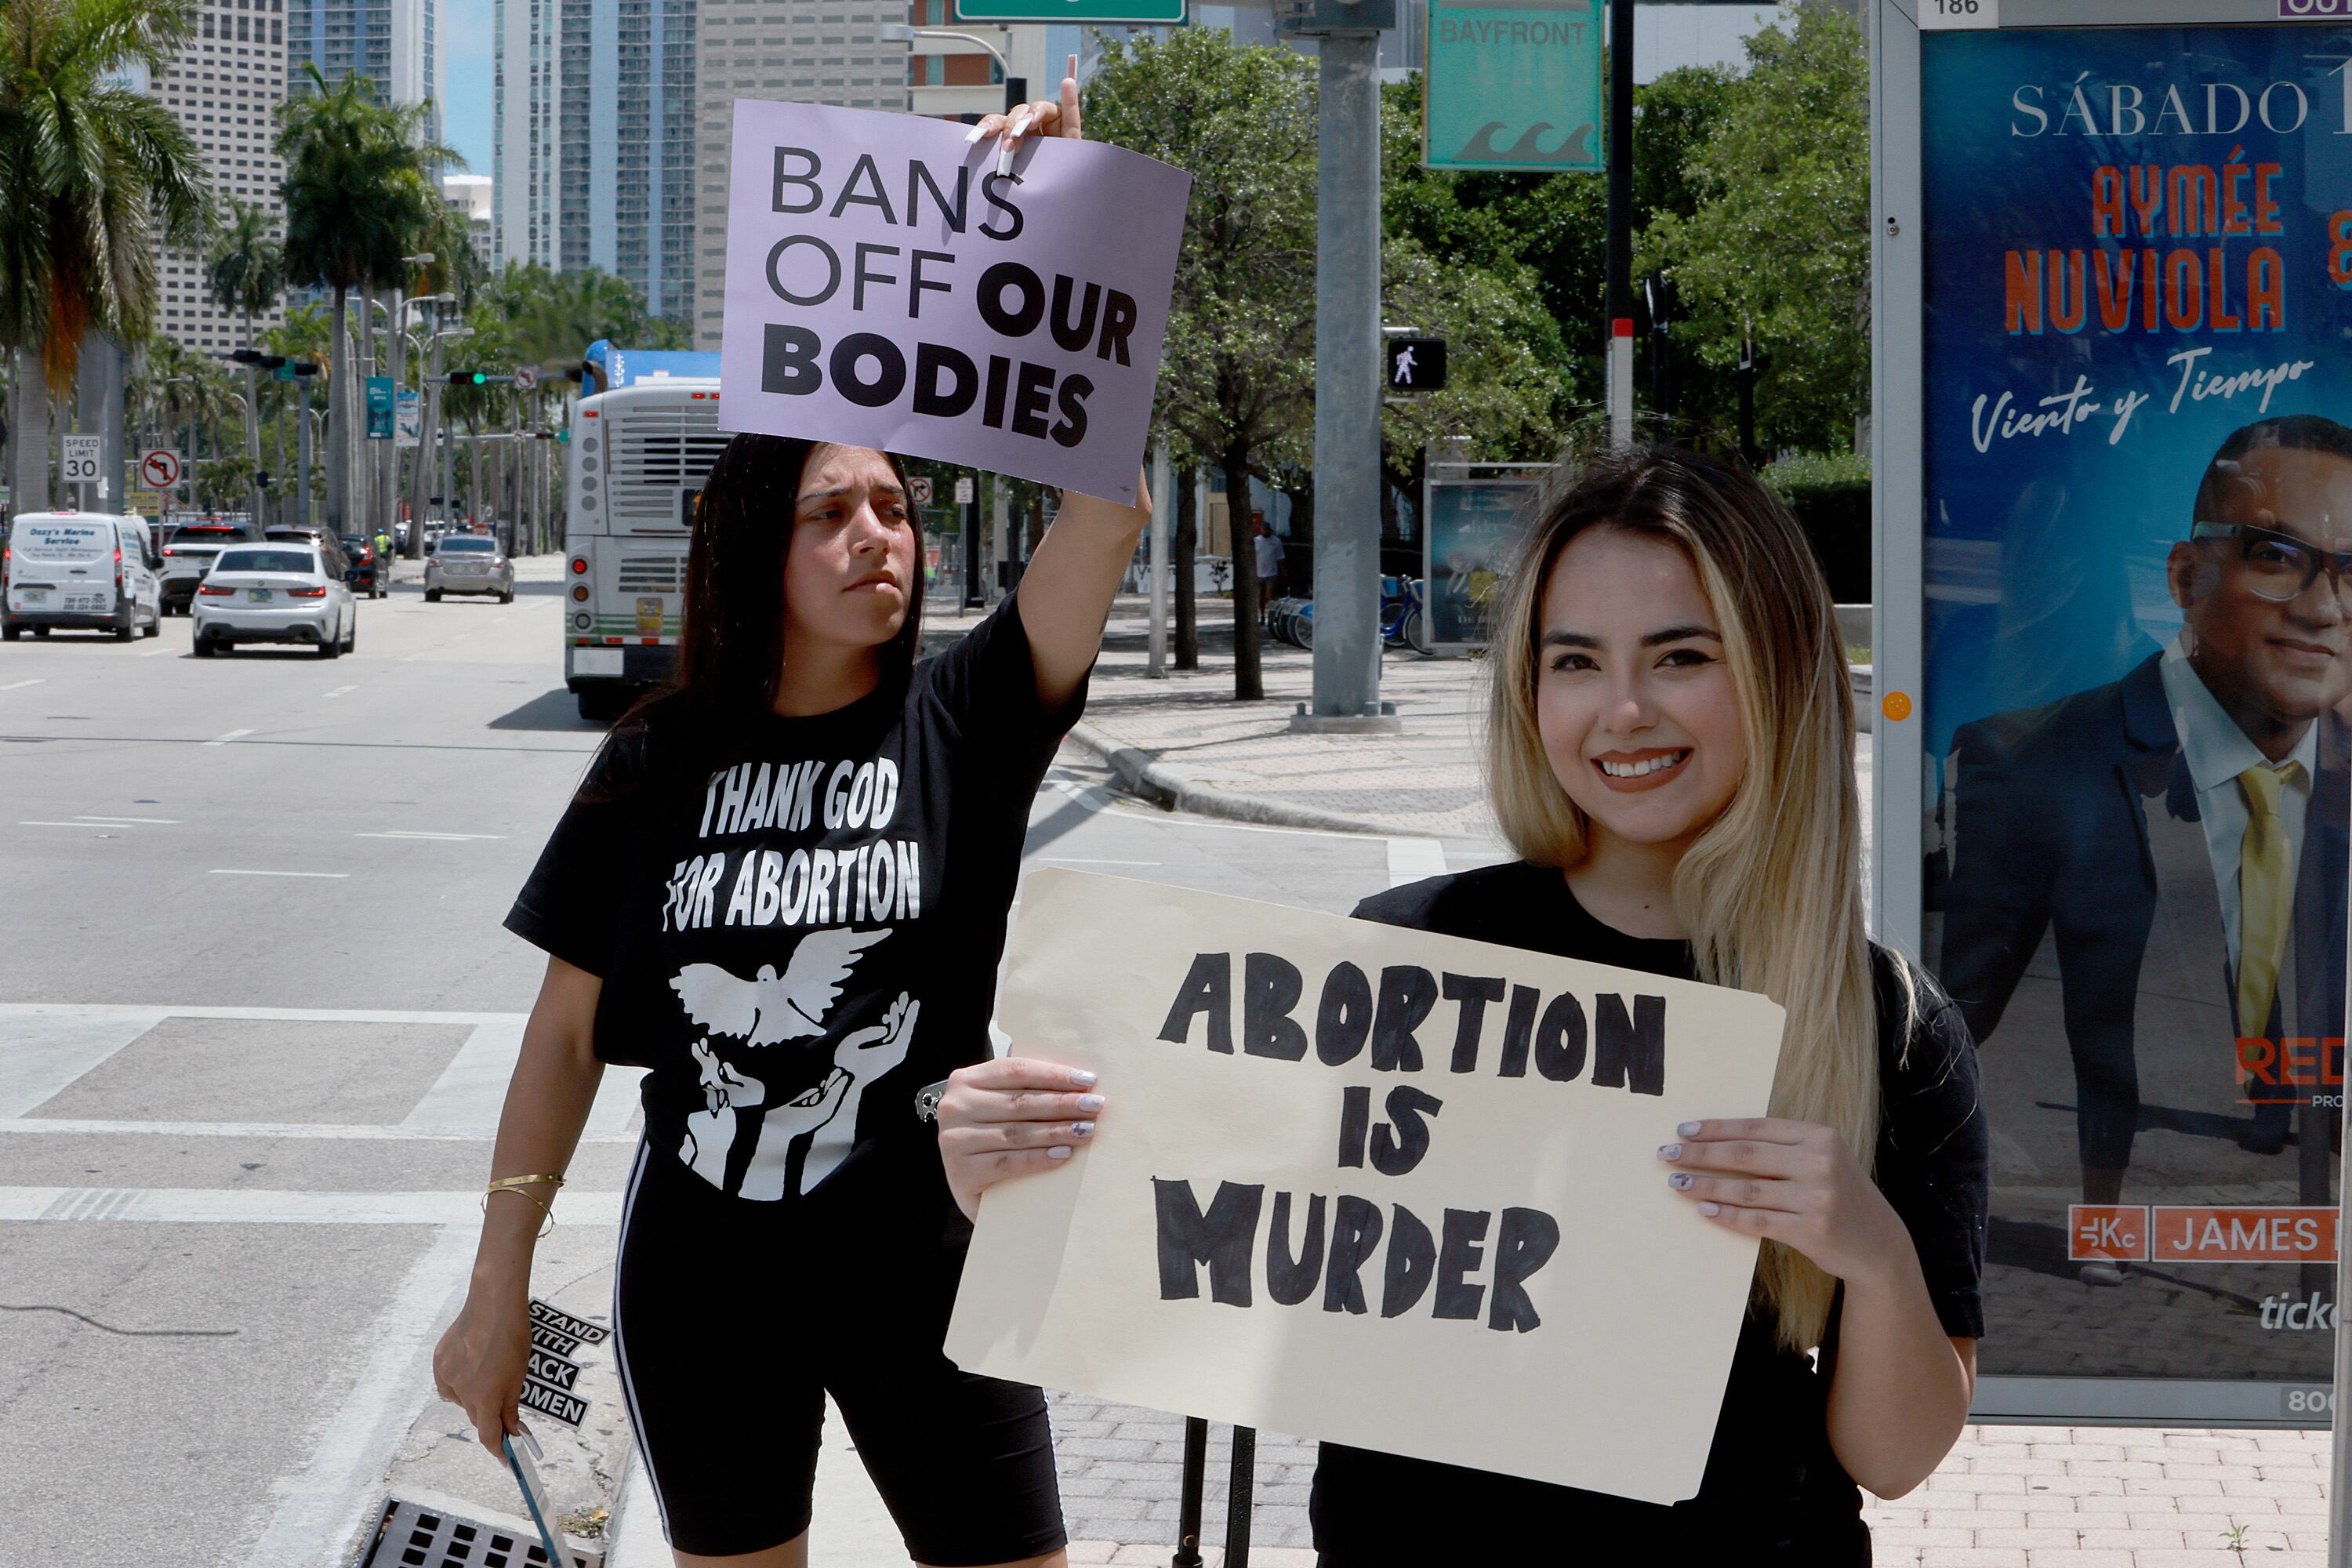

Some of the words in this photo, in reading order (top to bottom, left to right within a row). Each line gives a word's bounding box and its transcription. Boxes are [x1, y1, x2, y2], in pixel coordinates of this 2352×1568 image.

[1441, 19, 1588, 46] BAYFRONT
[1934, 0, 1978, 14] 186
[2012, 71, 2309, 136] SÁBADO
[771, 146, 1024, 241] BANS
[2092, 144, 2285, 238] AYMÉE
[765, 235, 955, 318] OFF
[977, 262, 1138, 368] OUR
[2005, 247, 2286, 336] NUVIOLA
[761, 323, 1094, 448] BODIES
[1972, 374, 2100, 453] Viento
[2108, 390, 2149, 445] y
[2167, 347, 2314, 414] Tiempo
[66, 459, 96, 477] 30
[699, 760, 826, 837] THANK
[823, 757, 899, 830] GOD
[662, 852, 726, 932] FOR
[724, 838, 920, 927] ABORTION
[1156, 951, 1666, 1097] ABORTION
[1337, 1085, 1443, 1177] IS
[1149, 1174, 1560, 1333] MURDER
[2172, 1218, 2318, 1251] JAMES
[529, 1304, 604, 1341] STAND
[531, 1326, 575, 1353] ITH
[520, 1383, 583, 1422] OMEN
[528, 1354, 575, 1387] ACK
